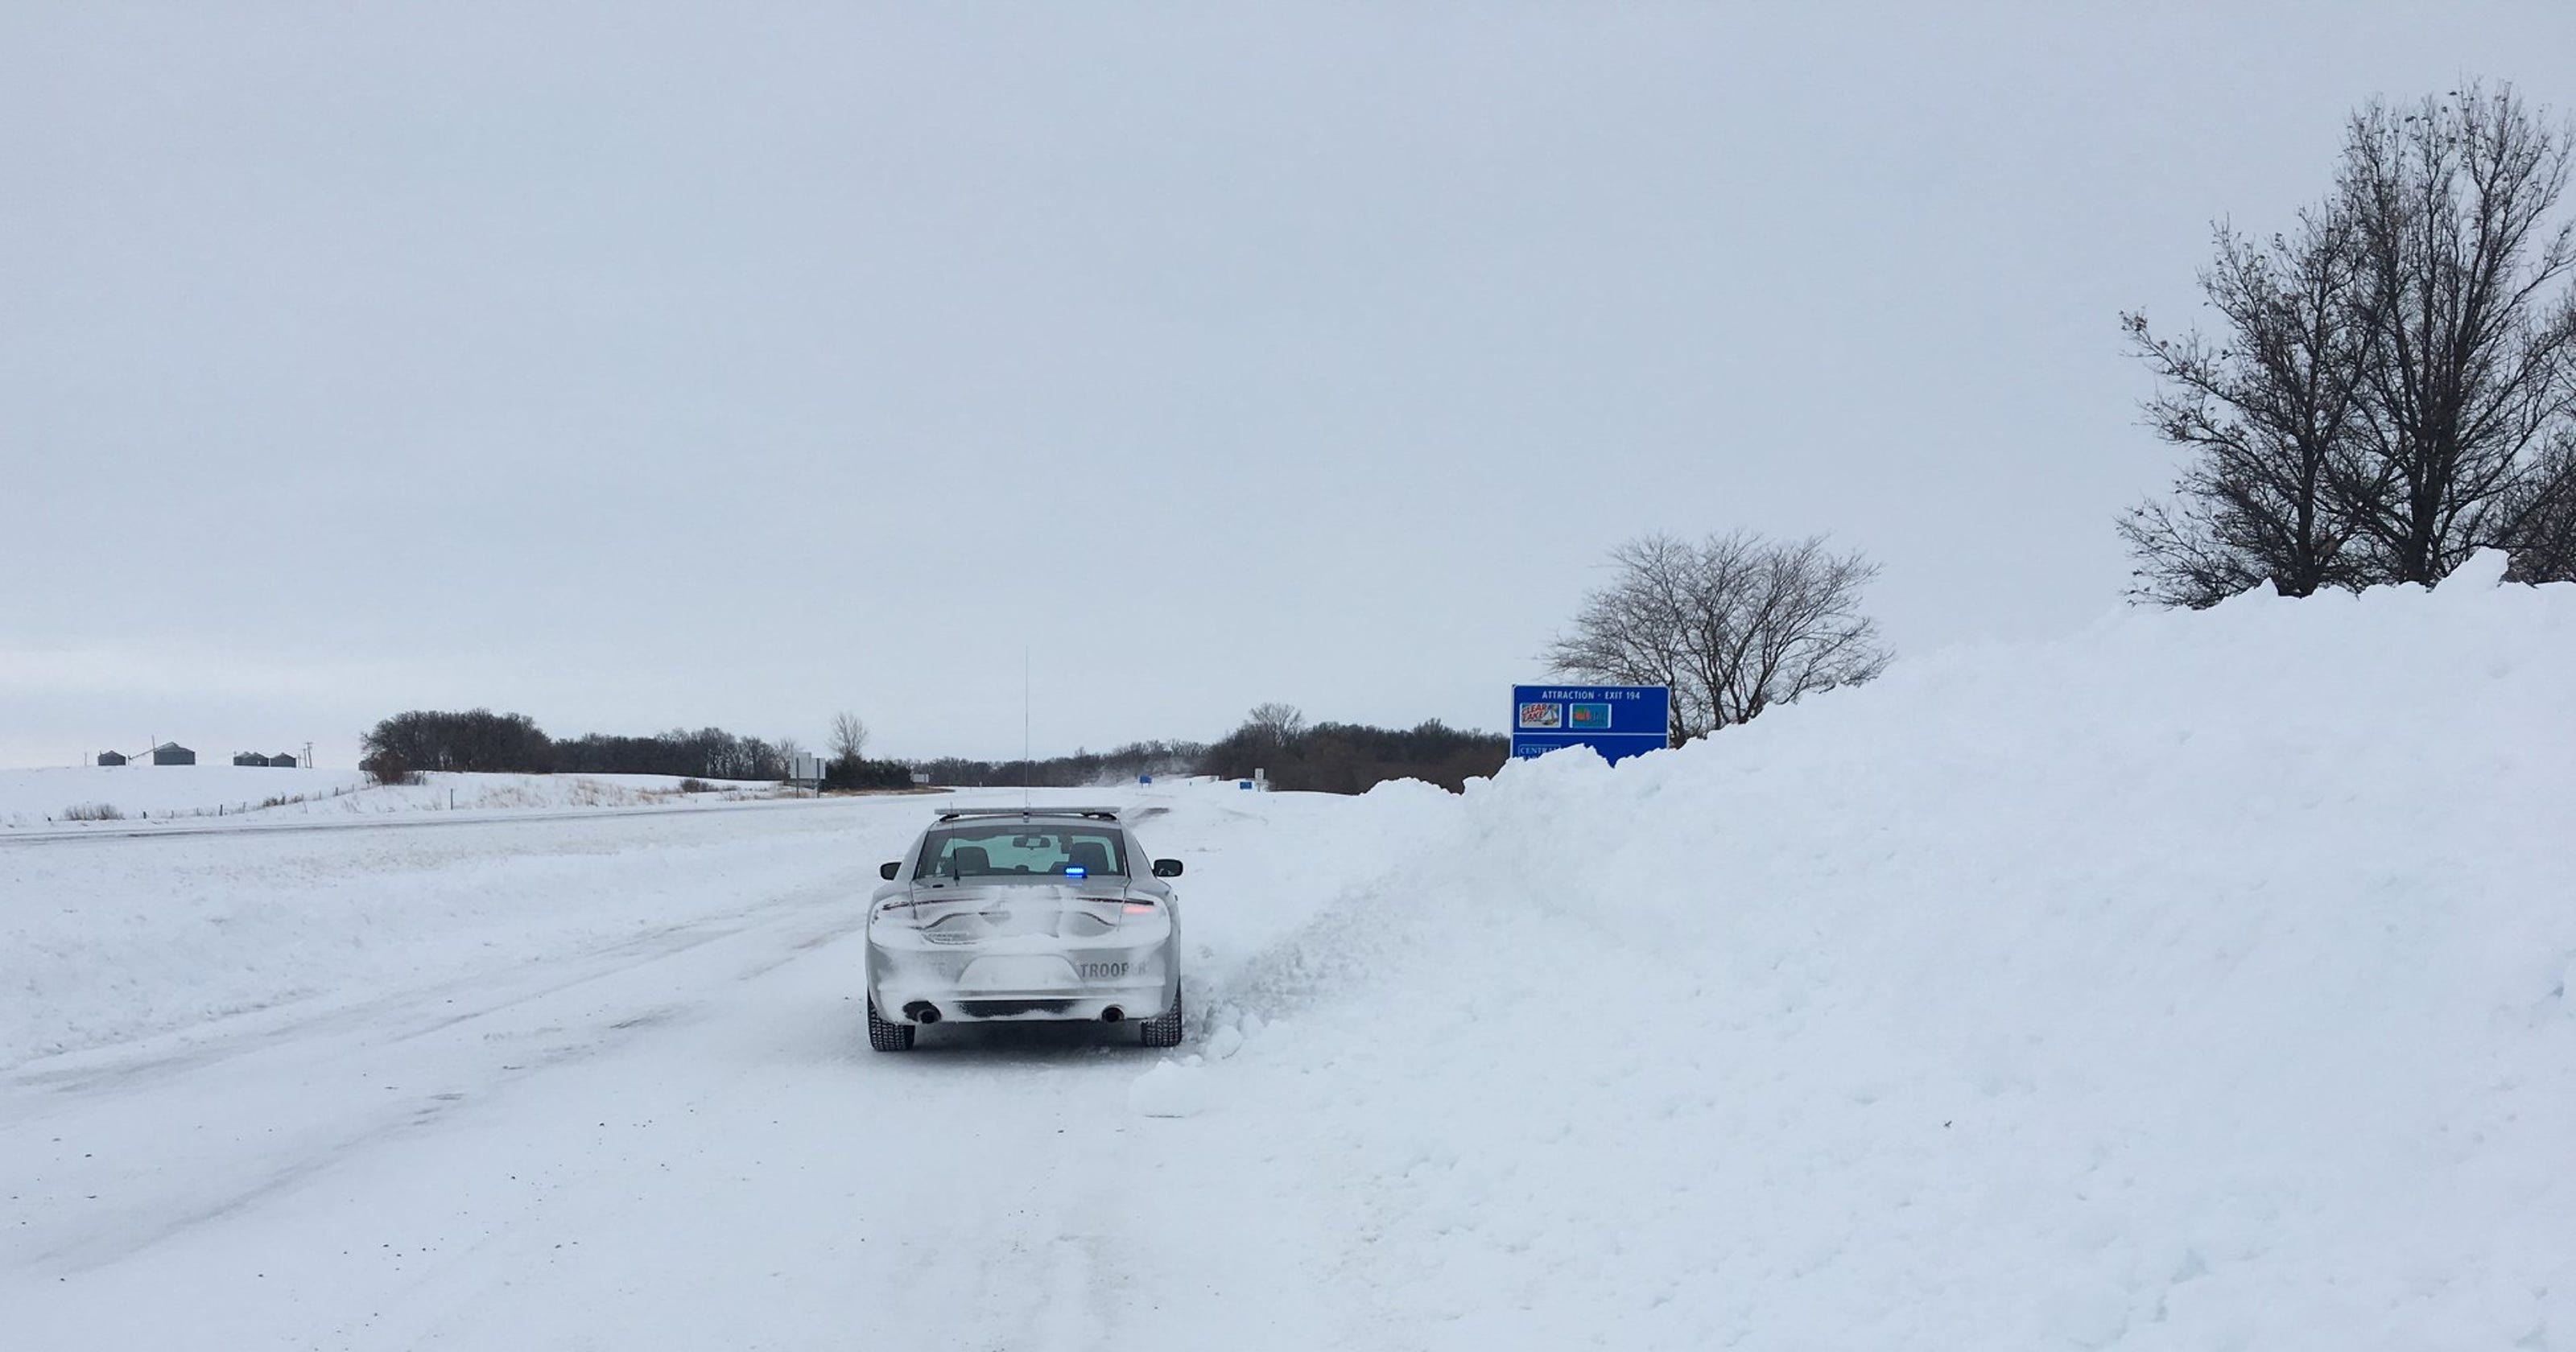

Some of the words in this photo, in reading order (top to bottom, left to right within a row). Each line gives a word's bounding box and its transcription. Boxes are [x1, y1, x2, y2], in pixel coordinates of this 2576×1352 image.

[1542, 690, 1595, 699] ATTRACTION
[1604, 690, 1623, 699] EXIT
[1626, 690, 1641, 699] 194
[1521, 703, 1547, 715] CLEAR
[1522, 711, 1543, 723] LAKE
